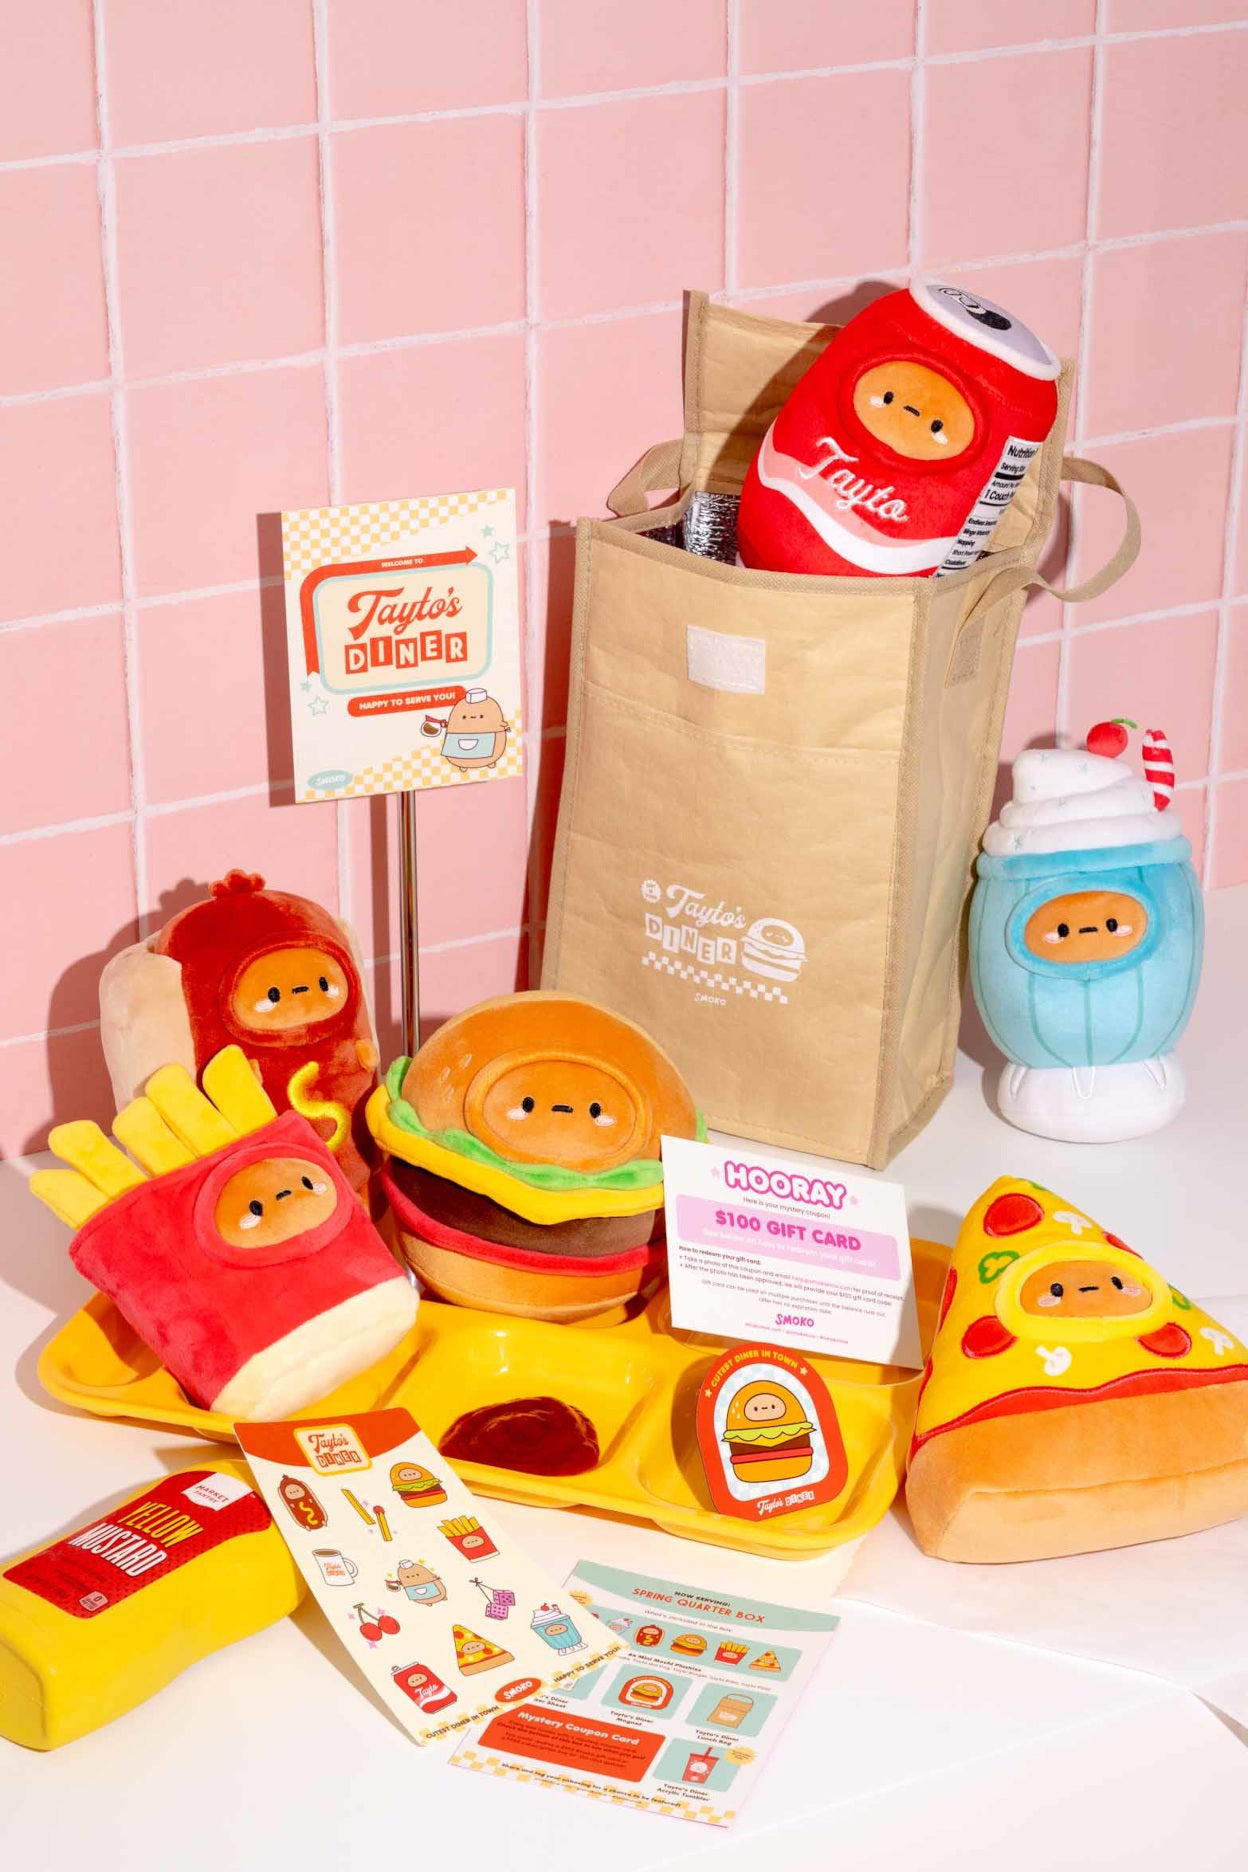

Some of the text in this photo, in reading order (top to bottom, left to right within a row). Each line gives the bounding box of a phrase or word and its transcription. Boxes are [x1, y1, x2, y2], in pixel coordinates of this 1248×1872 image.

[800, 436, 909, 522] Tayto
[1001, 462, 1019, 474] Serving
[381, 559, 412, 568] WELCOME
[347, 586, 463, 640] Tayto's
[345, 630, 467, 674] DINER
[359, 700, 388, 710] HAPPY
[406, 695, 431, 705] SERVE
[433, 692, 456, 700] YOU!
[666, 884, 746, 929] Tayto's
[644, 912, 737, 965] DINER
[694, 993, 726, 1006] SMOKO
[724, 1160, 847, 1209] HOORAY
[715, 1210, 761, 1231] $100
[767, 1221, 806, 1240] GIFT
[812, 1230, 861, 1251] CARD
[775, 1314, 814, 1328] SMOKO
[711, 1350, 798, 1388] CUTEST DINER IN TOWN
[308, 1433, 348, 1453] Tayto's
[316, 1450, 361, 1468] DINER
[195, 1485, 229, 1502] MARKET
[117, 1501, 204, 1548] YELLOW
[68, 1522, 167, 1577] MUSTARD
[632, 1588, 766, 1623] SPRING QUARTER BOX
[554, 1670, 574, 1682] HAPPY
[585, 1656, 604, 1667] SERVE
[504, 1681, 533, 1700] SMOKO
[426, 1726, 450, 1738] CUTEST
[451, 1719, 471, 1729] DINER
[478, 1706, 499, 1717] TOWN
[518, 1711, 640, 1745] Mystery Coupon Card
